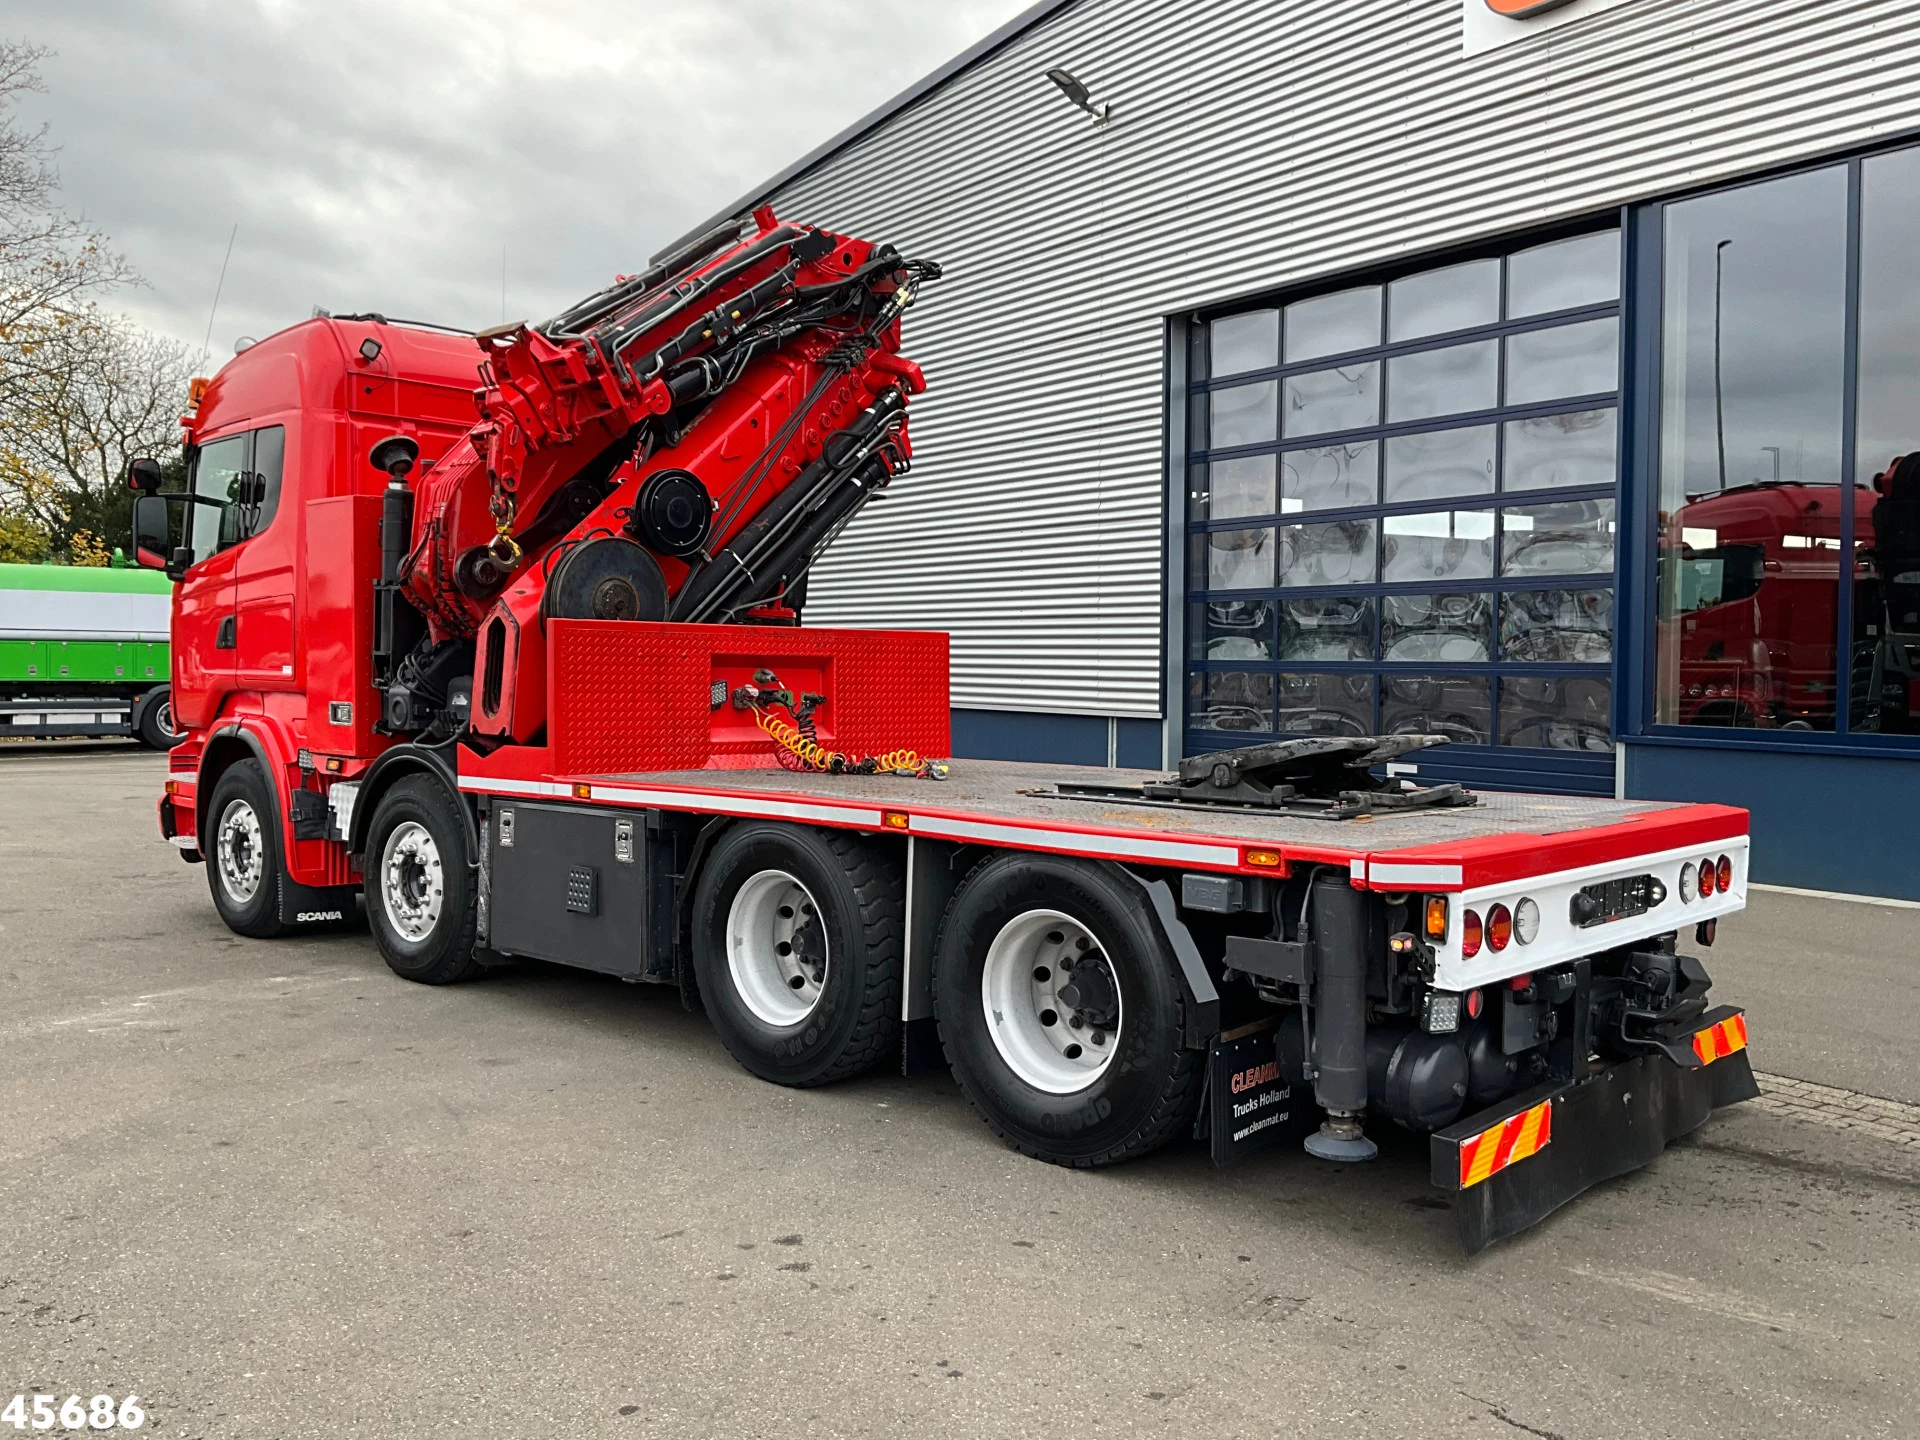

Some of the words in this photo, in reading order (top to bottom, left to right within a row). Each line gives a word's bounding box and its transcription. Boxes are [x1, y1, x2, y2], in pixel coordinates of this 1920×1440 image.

[296, 911, 342, 921] SCANIA
[1233, 1098, 1258, 1118] Trucks
[1259, 1085, 1291, 1107] Holland
[1233, 1112, 1289, 1141] www.cleanmat.eu
